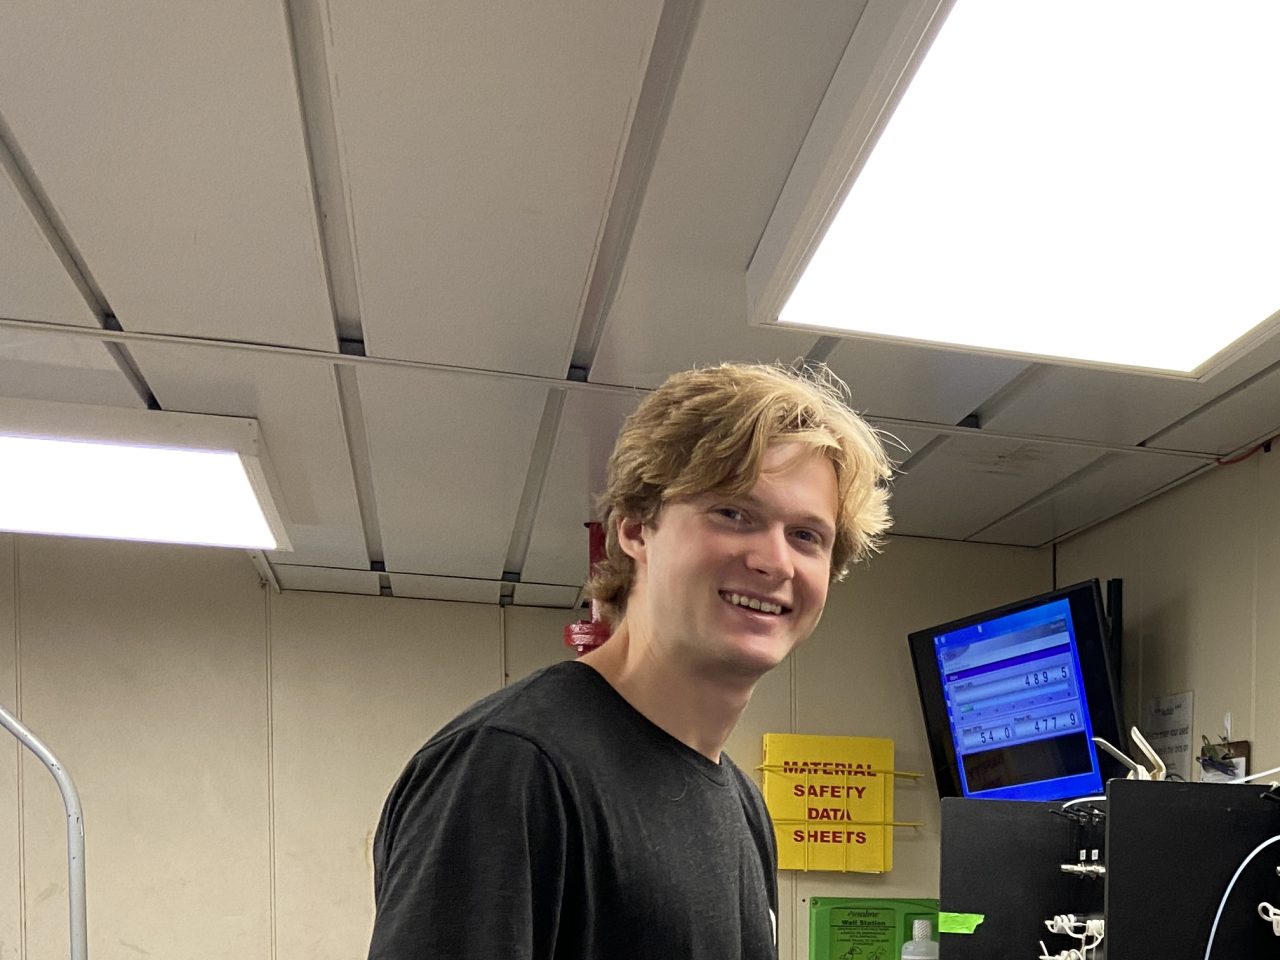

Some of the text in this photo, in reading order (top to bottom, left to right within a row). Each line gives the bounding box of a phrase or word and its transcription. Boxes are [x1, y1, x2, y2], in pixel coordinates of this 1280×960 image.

[783, 761, 877, 776] MATERIAL
[793, 784, 867, 799] SAFETY
[807, 807, 852, 821] DATA
[793, 830, 867, 845] SHEETS
